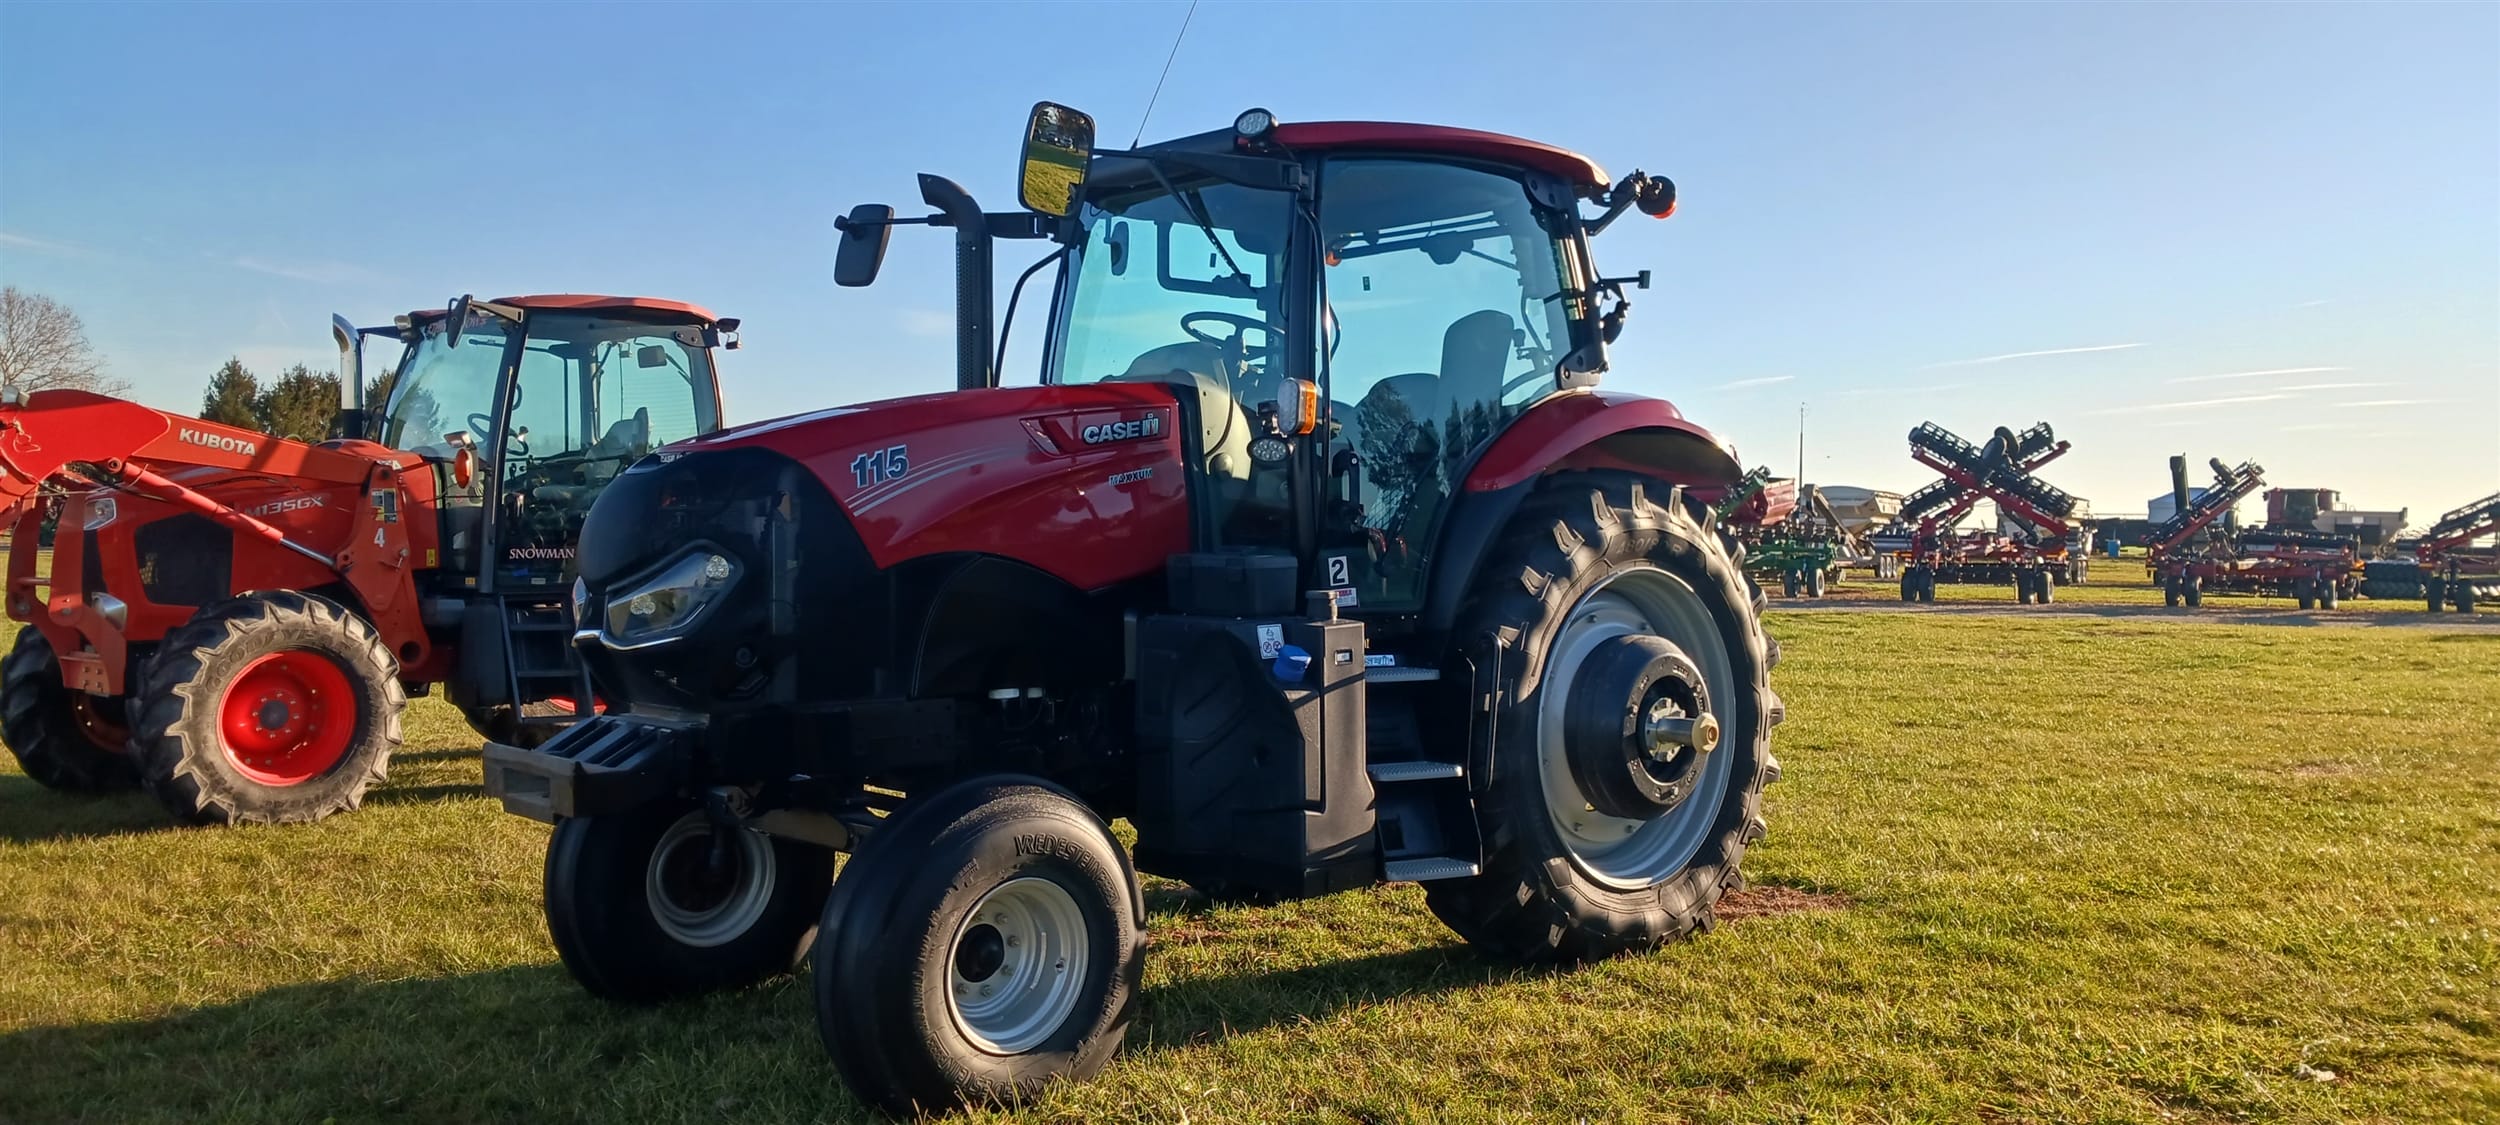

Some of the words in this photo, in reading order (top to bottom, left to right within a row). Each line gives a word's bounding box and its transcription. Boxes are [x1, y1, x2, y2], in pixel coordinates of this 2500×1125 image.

[179, 428, 256, 456] KUBOTA
[1083, 422, 1140, 444] CASE
[850, 444, 909, 489] 115
[1108, 467, 1153, 486] MAXXUM
[374, 528, 385, 548] 4
[509, 548, 575, 560] SNOWMAN
[1331, 559, 1346, 584] 2
